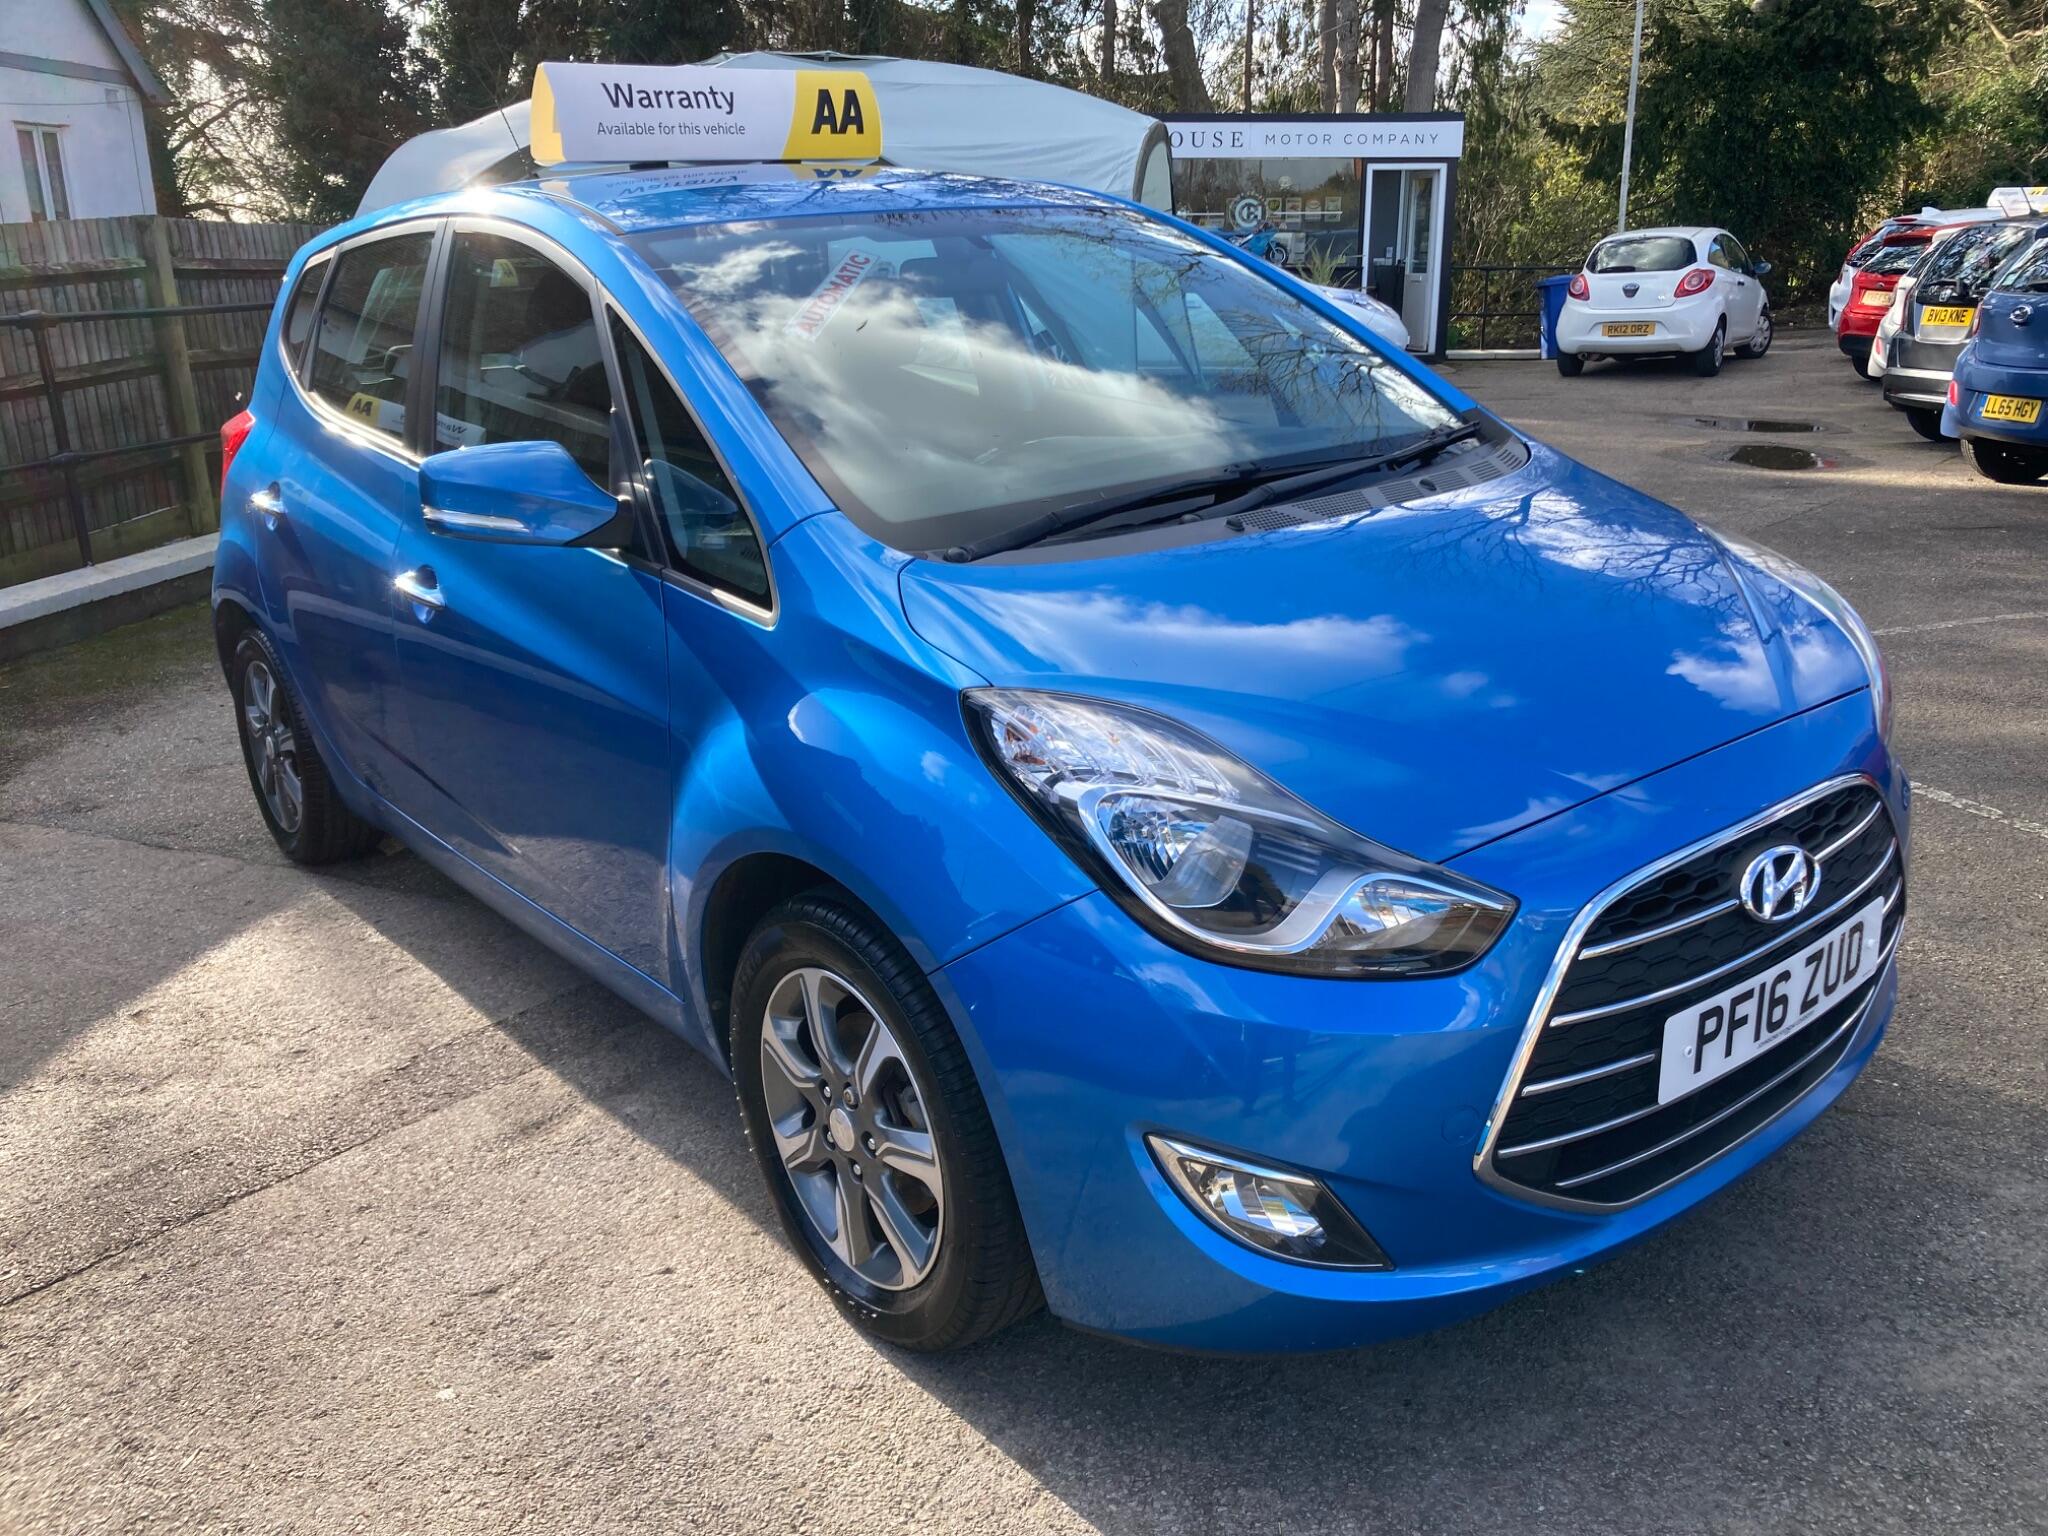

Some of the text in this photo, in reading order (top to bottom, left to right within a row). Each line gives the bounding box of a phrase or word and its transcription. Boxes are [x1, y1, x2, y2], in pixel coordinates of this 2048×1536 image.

[601, 82, 735, 114] Warranty
[811, 88, 865, 135] AA
[597, 121, 746, 136] Available for this vehicle
[1265, 133, 1333, 145] MOTOR
[1343, 133, 1439, 145] COMPANY
[797, 254, 871, 334] AUTOMATIC
[1926, 307, 1967, 323] BV13 KNE
[1985, 398, 2036, 418] LL65 HGY
[1693, 920, 1865, 1075] PF16 ZUD
